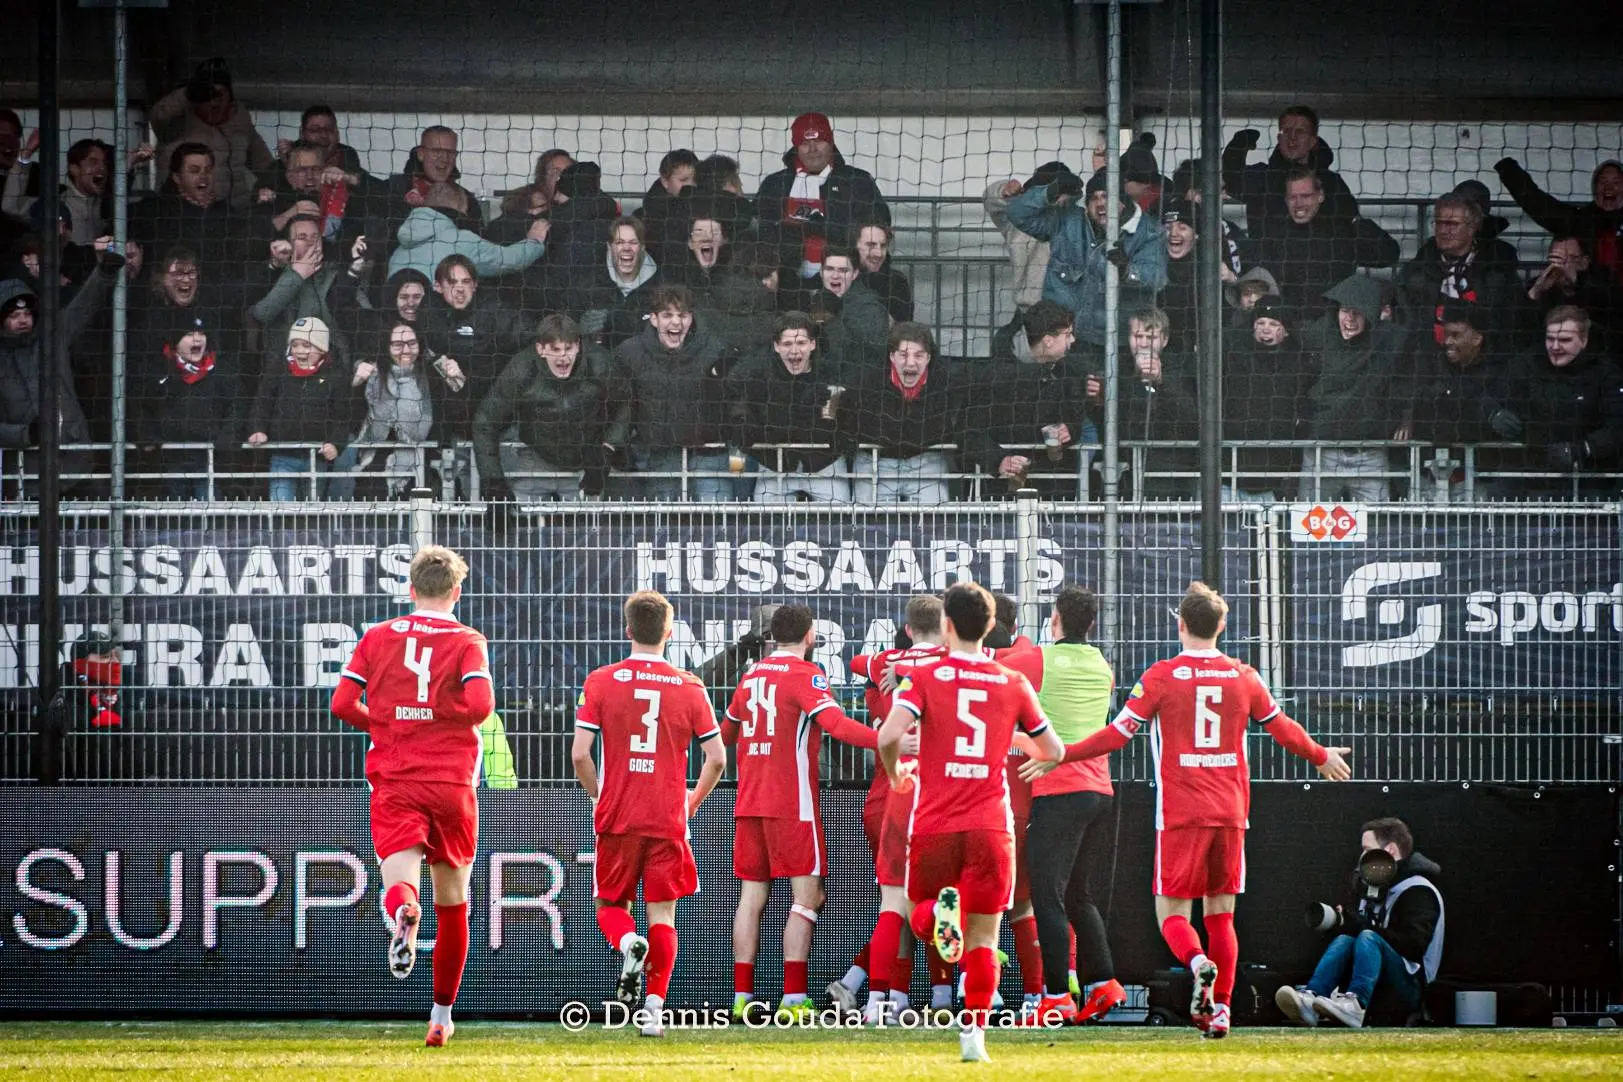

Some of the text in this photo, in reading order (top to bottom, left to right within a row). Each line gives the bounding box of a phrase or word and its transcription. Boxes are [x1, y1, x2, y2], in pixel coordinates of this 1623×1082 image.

[0, 544, 412, 596] HUSSAARTS
[636, 538, 1064, 592] HUSSAARTS
[404, 636, 433, 703] 4
[636, 670, 683, 686] leaseweb
[395, 705, 434, 720] DEKKER
[630, 688, 661, 754] 3
[742, 676, 777, 738] 34
[955, 688, 988, 758] 5
[1194, 685, 1223, 748] 6
[629, 758, 655, 773] GOES
